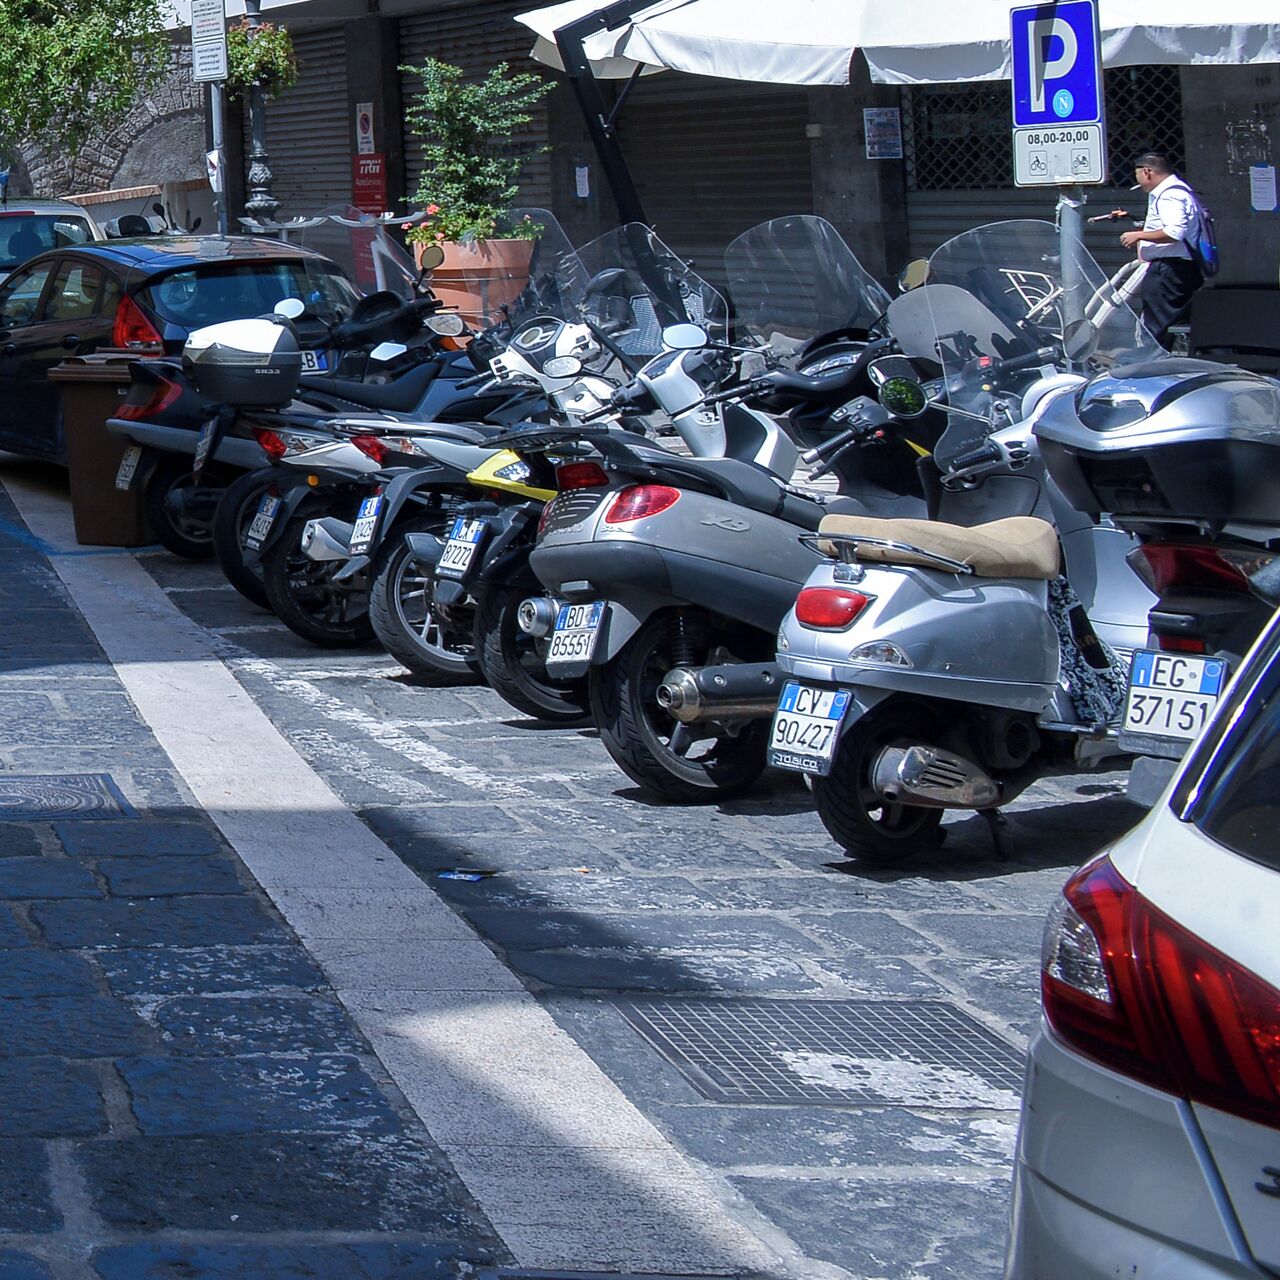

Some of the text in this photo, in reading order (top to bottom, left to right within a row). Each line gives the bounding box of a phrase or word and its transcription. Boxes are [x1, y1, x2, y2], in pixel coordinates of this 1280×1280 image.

[1027, 18, 1078, 113] P
[1027, 131, 1089, 145] 08,00-20,00
[442, 544, 472, 567] 87272
[567, 606, 585, 628] BD
[551, 634, 592, 657] 85551
[1152, 656, 1188, 688] EG
[795, 688, 823, 714] CV
[1130, 694, 1209, 731] 37151
[776, 718, 834, 751] 90427
